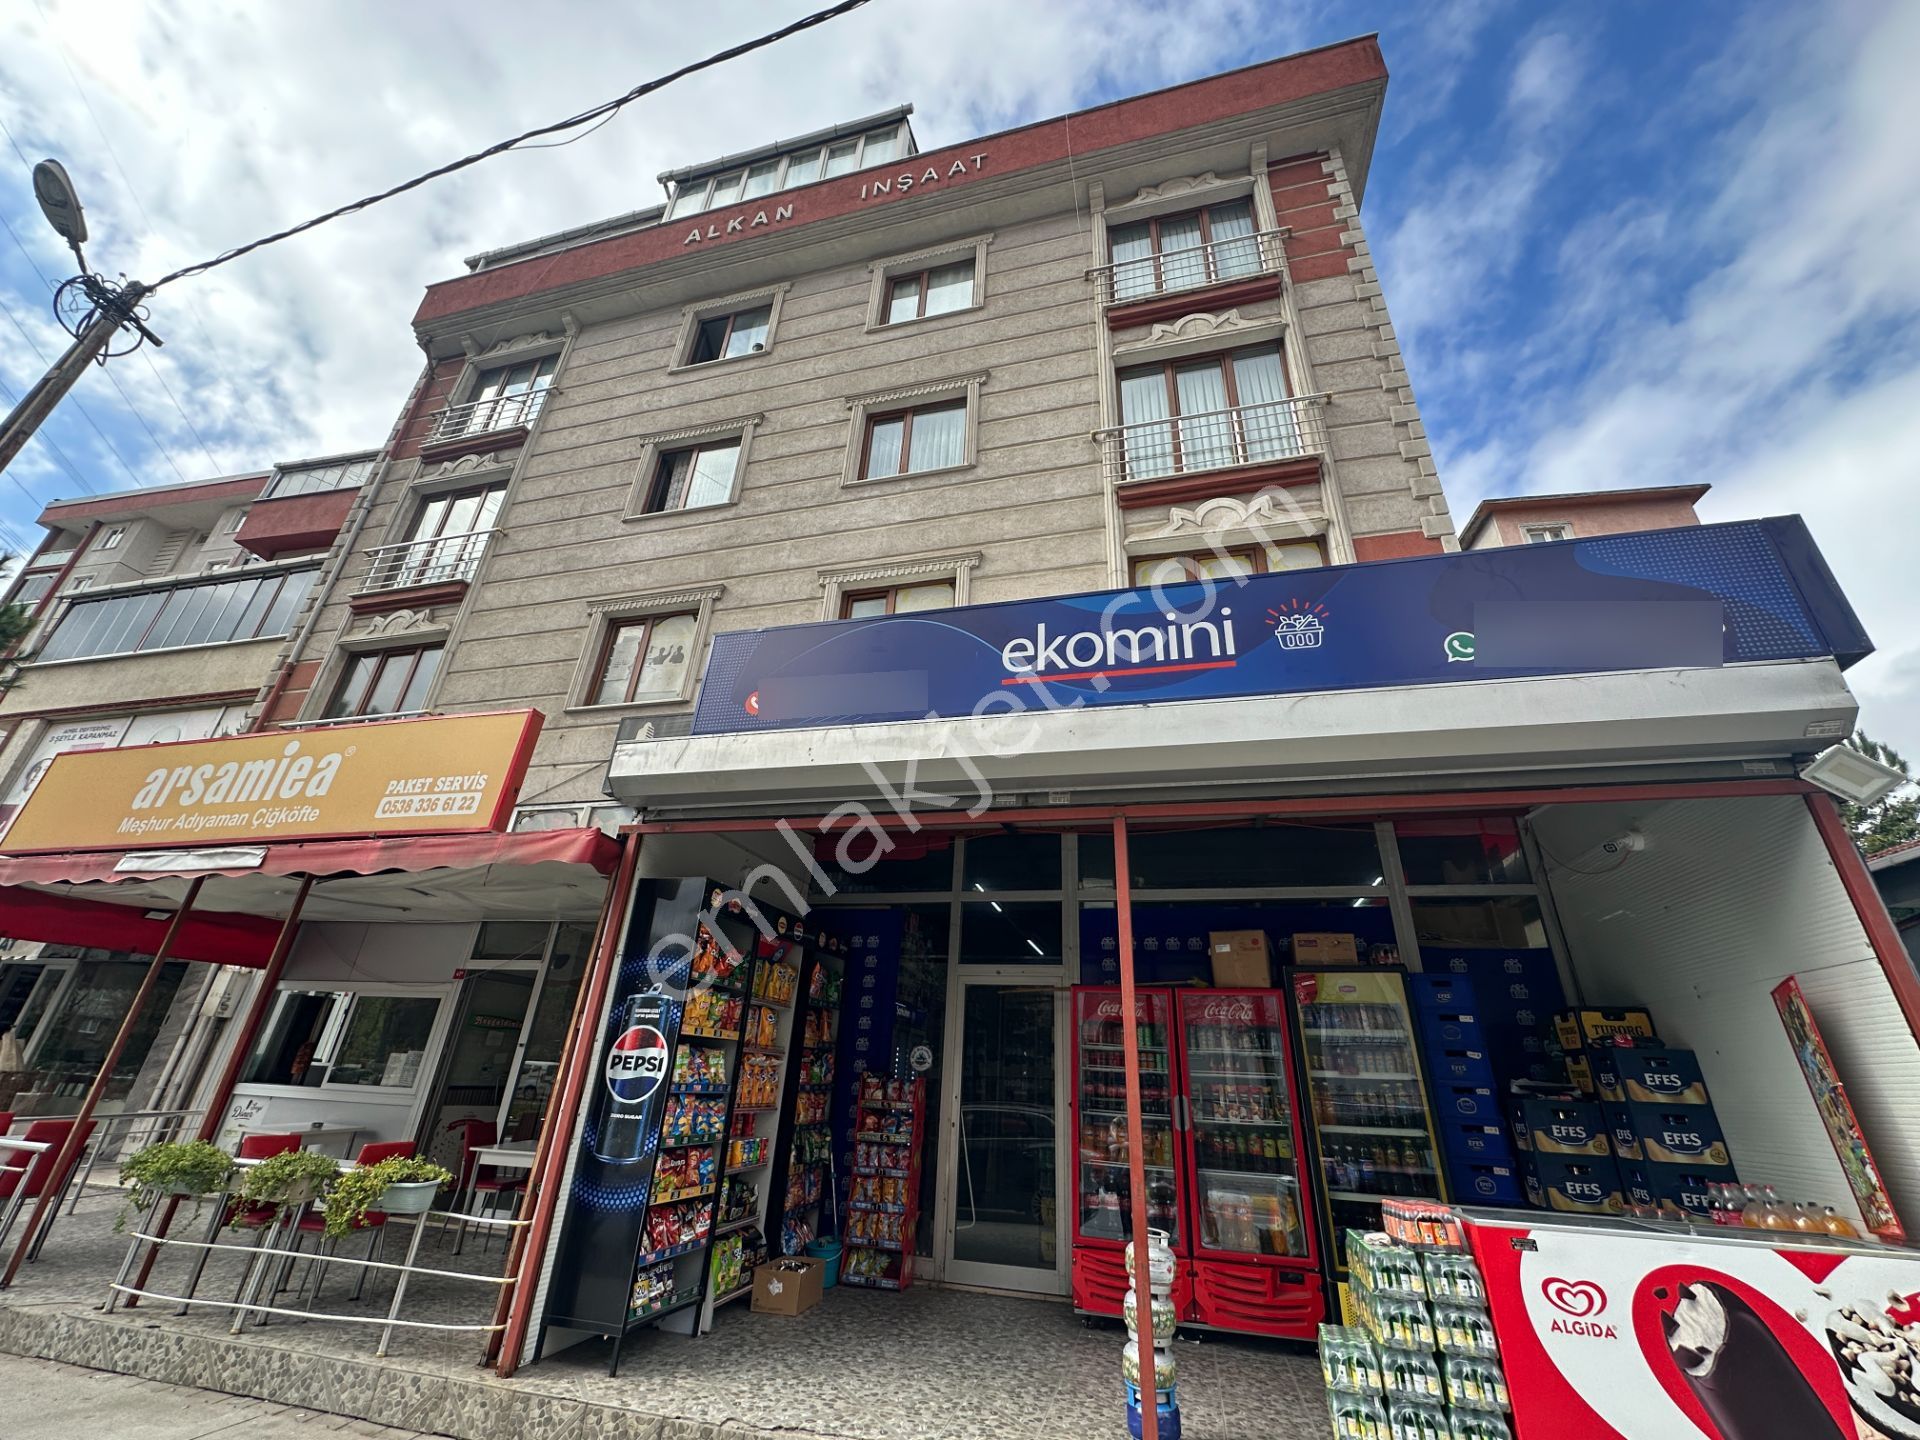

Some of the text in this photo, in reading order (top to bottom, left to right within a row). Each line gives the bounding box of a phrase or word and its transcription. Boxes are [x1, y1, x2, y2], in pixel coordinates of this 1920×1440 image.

[683, 203, 795, 246] ALKAN
[1002, 607, 1236, 673] ekomini
[78, 731, 118, 740] KAPANMAZ
[132, 740, 343, 810] arsamiea
[384, 770, 489, 794] PAKET SERVİS
[381, 795, 476, 815] 0538 336 61 22
[117, 805, 321, 836] Meşhur Adıyaman Çiğköfte
[1592, 1024, 1644, 1037] TUBORG
[610, 1055, 664, 1073] PEPSI
[1644, 1073, 1682, 1086] EFES
[1551, 1124, 1587, 1138] EFES
[1663, 1132, 1702, 1146] EFES
[1565, 1182, 1602, 1196] EFES
[1632, 1187, 1649, 1201] EFES
[1681, 1192, 1709, 1206] EFE
